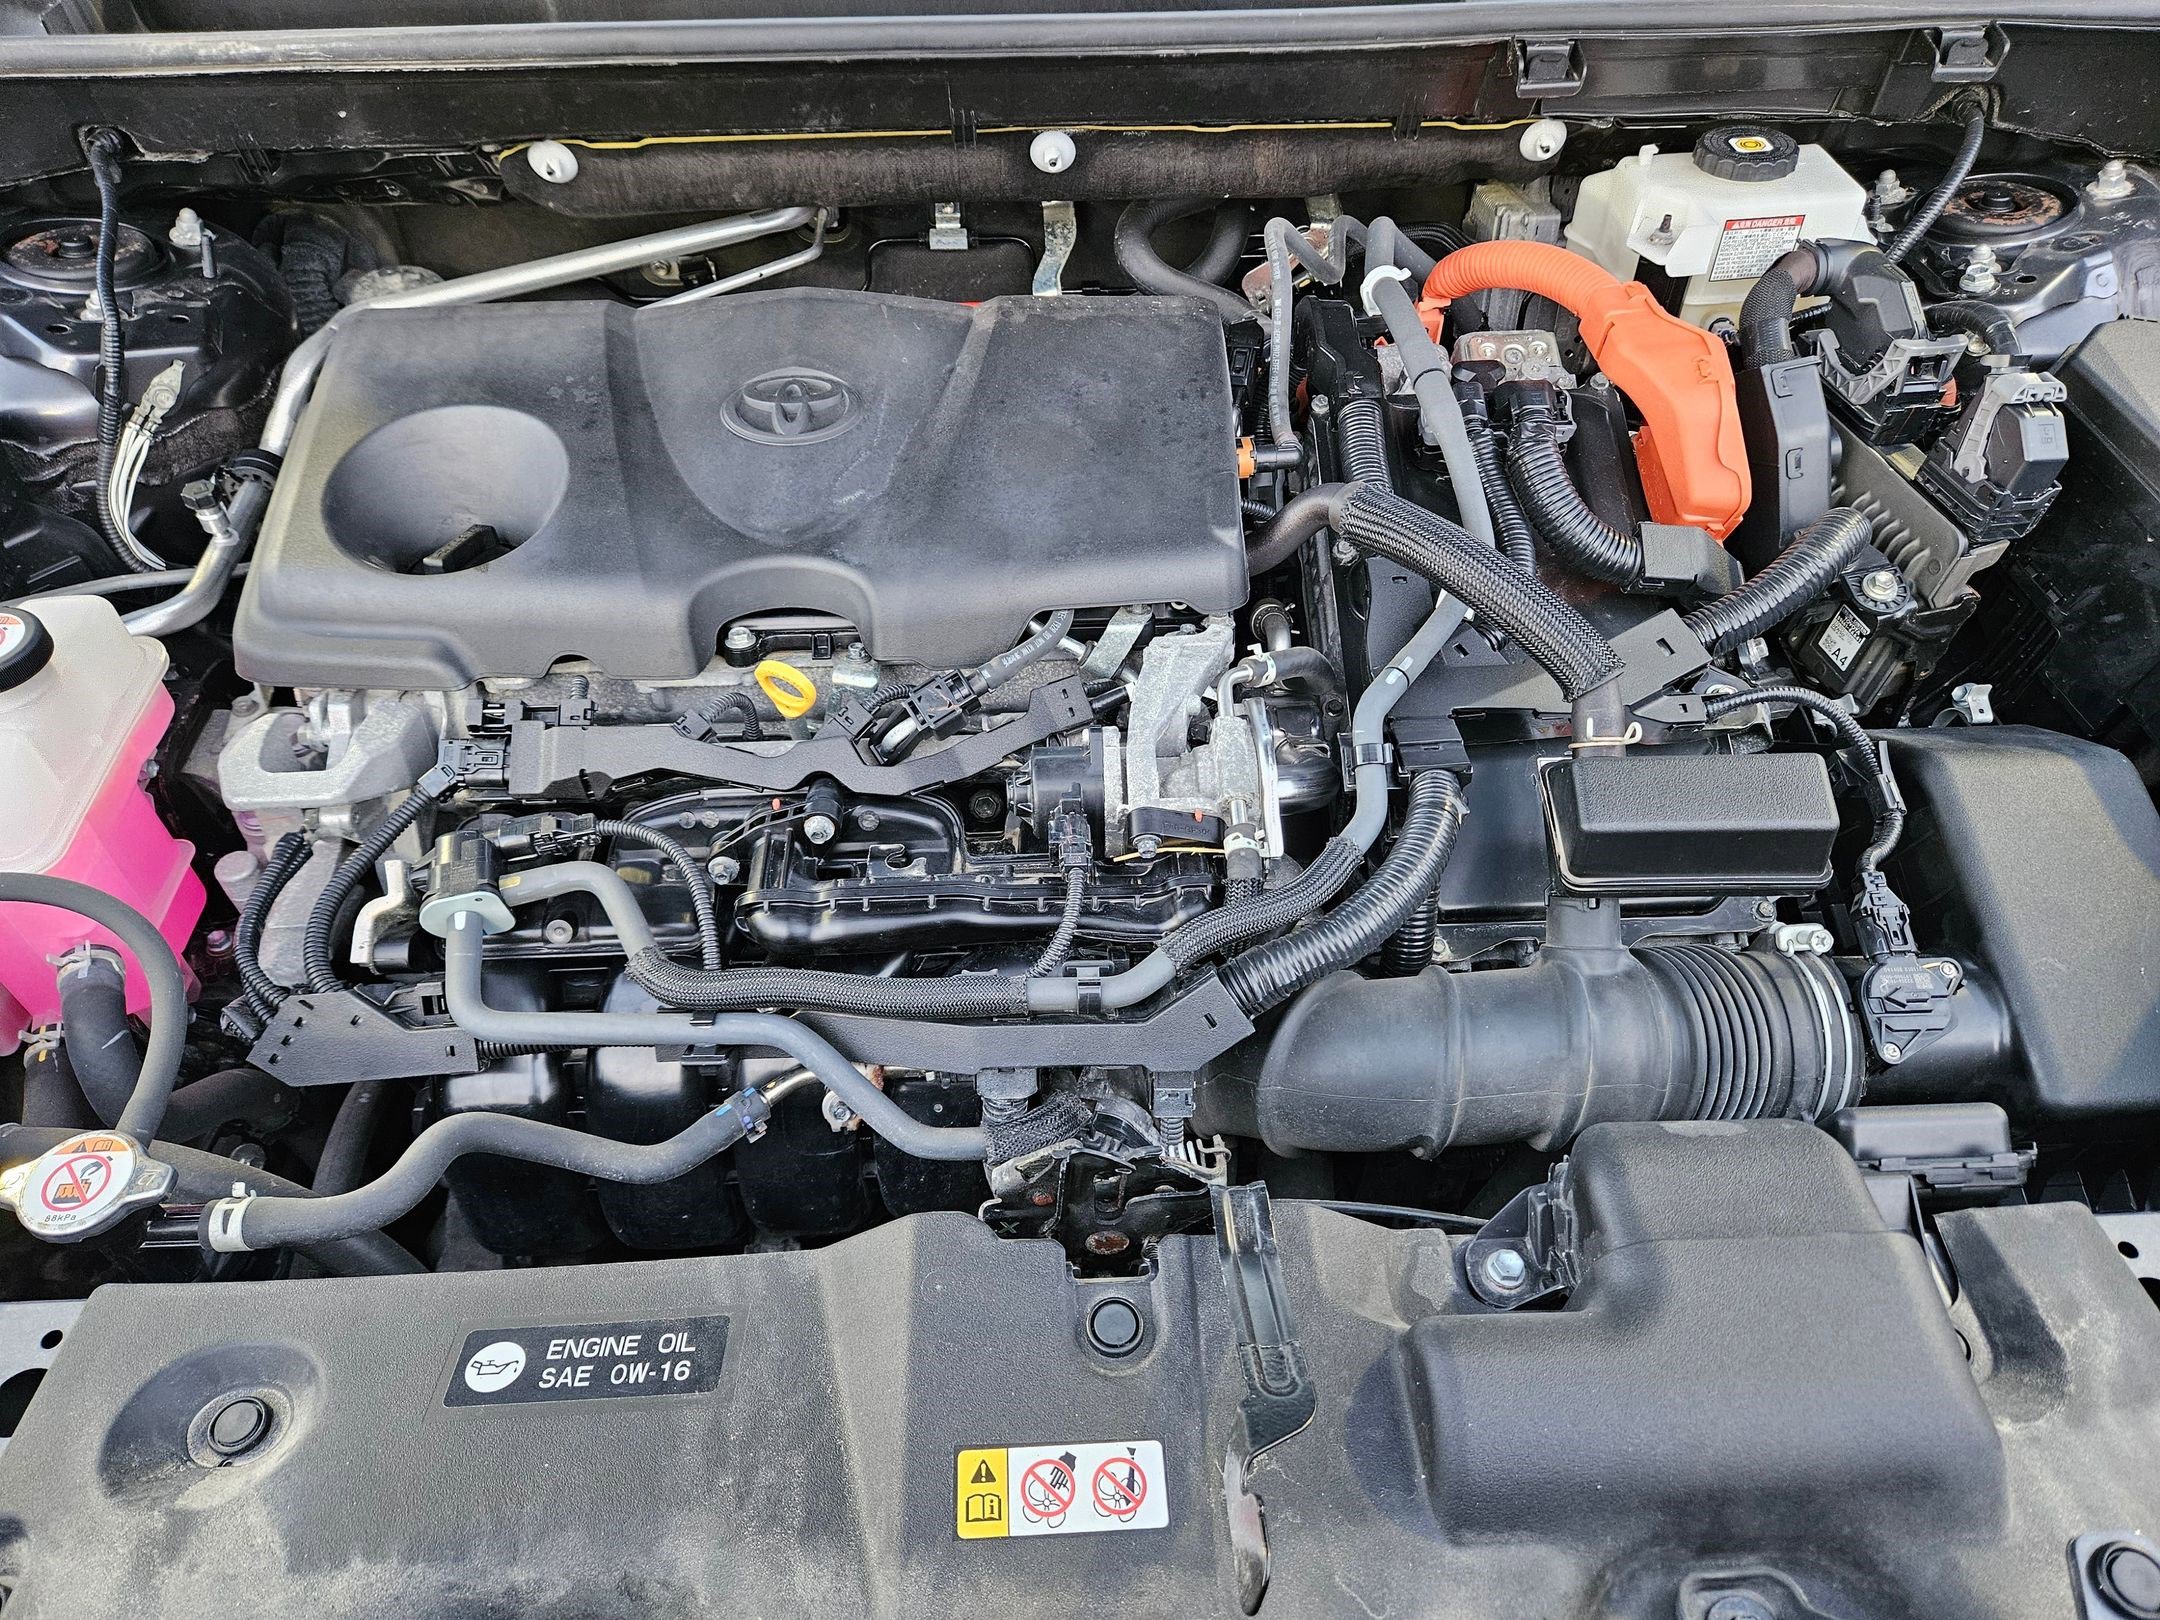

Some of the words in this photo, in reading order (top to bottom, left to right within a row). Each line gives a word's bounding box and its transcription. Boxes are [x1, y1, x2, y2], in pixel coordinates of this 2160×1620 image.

[1752, 219, 1783, 228] DANGER
[45, 1213, 77, 1222] 88kPa
[546, 1335, 642, 1360] ENGINE
[658, 1332, 696, 1354] OIL
[538, 1365, 594, 1389] SAE
